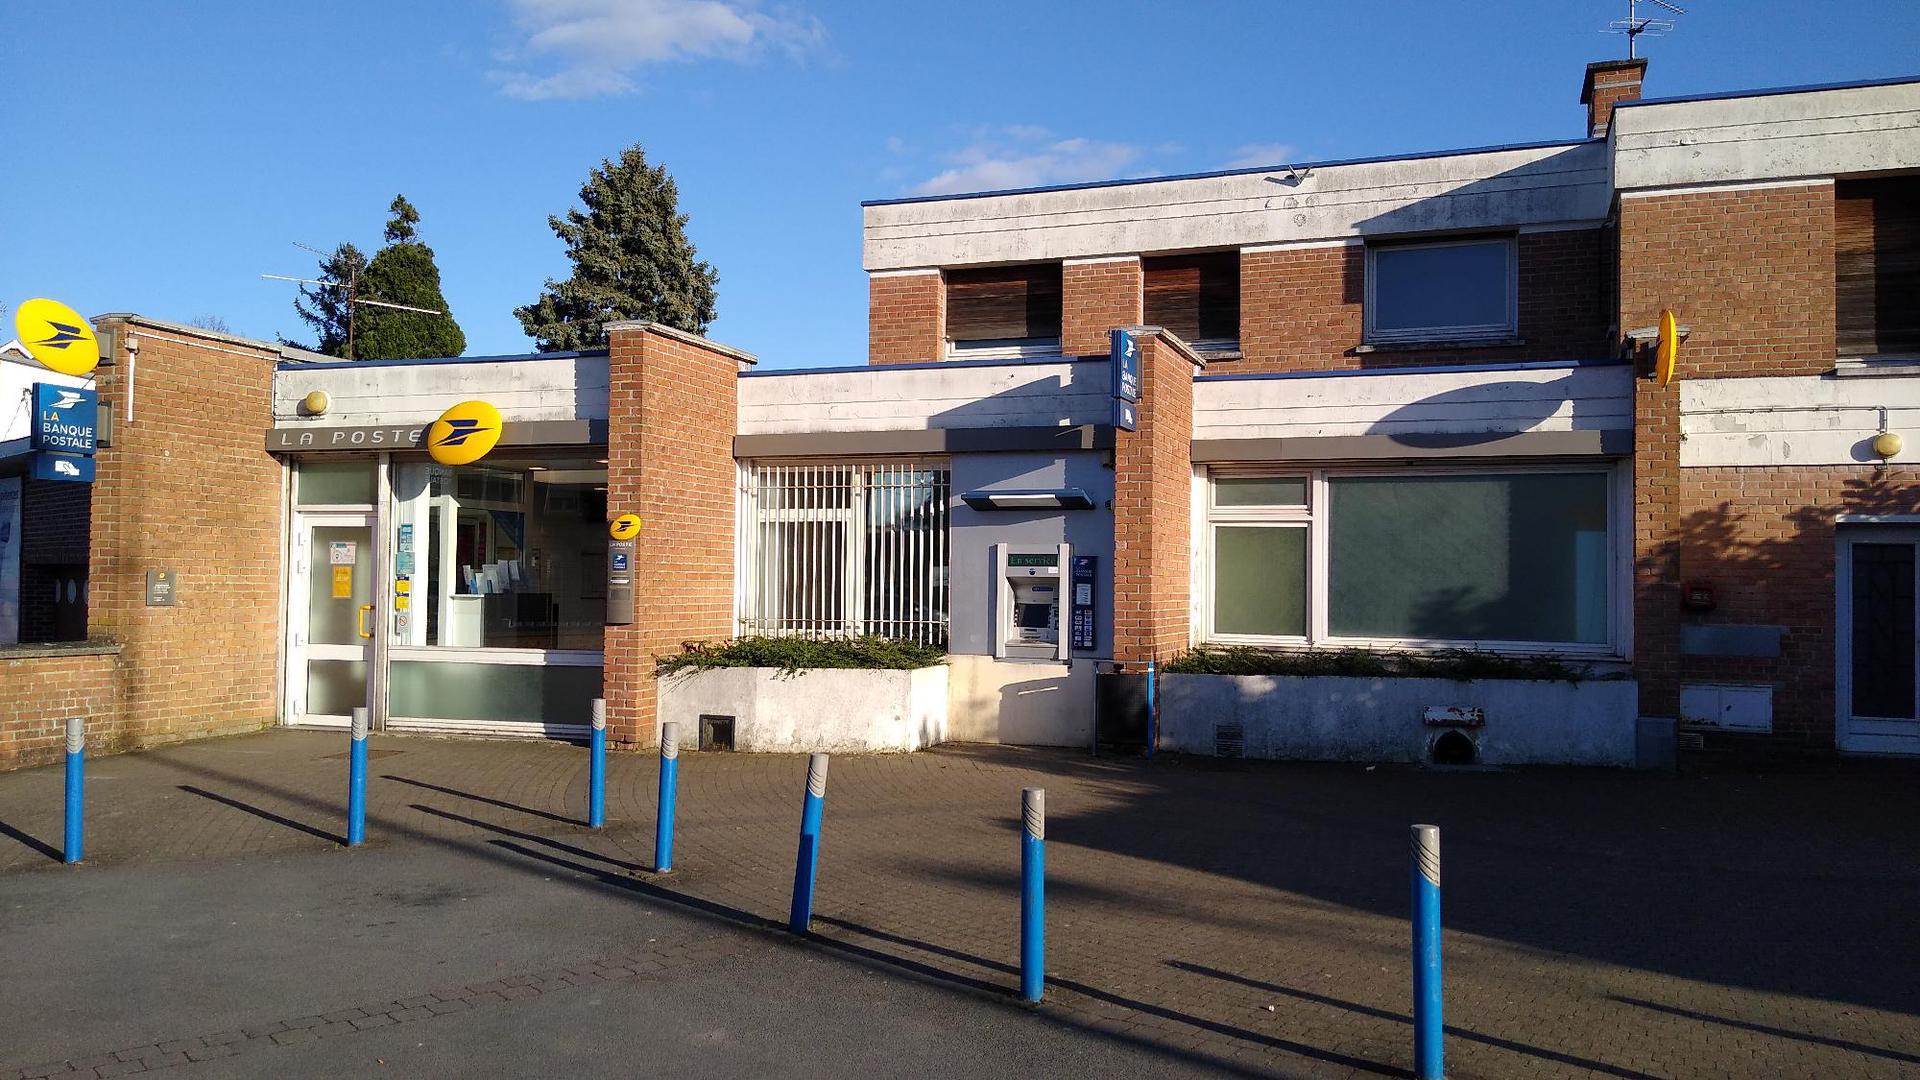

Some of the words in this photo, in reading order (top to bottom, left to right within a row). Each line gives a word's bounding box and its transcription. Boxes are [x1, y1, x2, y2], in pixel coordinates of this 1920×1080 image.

[1122, 359, 1129, 369] LA
[1121, 370, 1137, 387] BANQUE
[43, 410, 60, 422] LA
[42, 422, 93, 438] BANQUE
[281, 432, 313, 446] LA
[332, 429, 423, 445] POSTE
[42, 434, 92, 449] POSTALE
[1010, 555, 1023, 565] En
